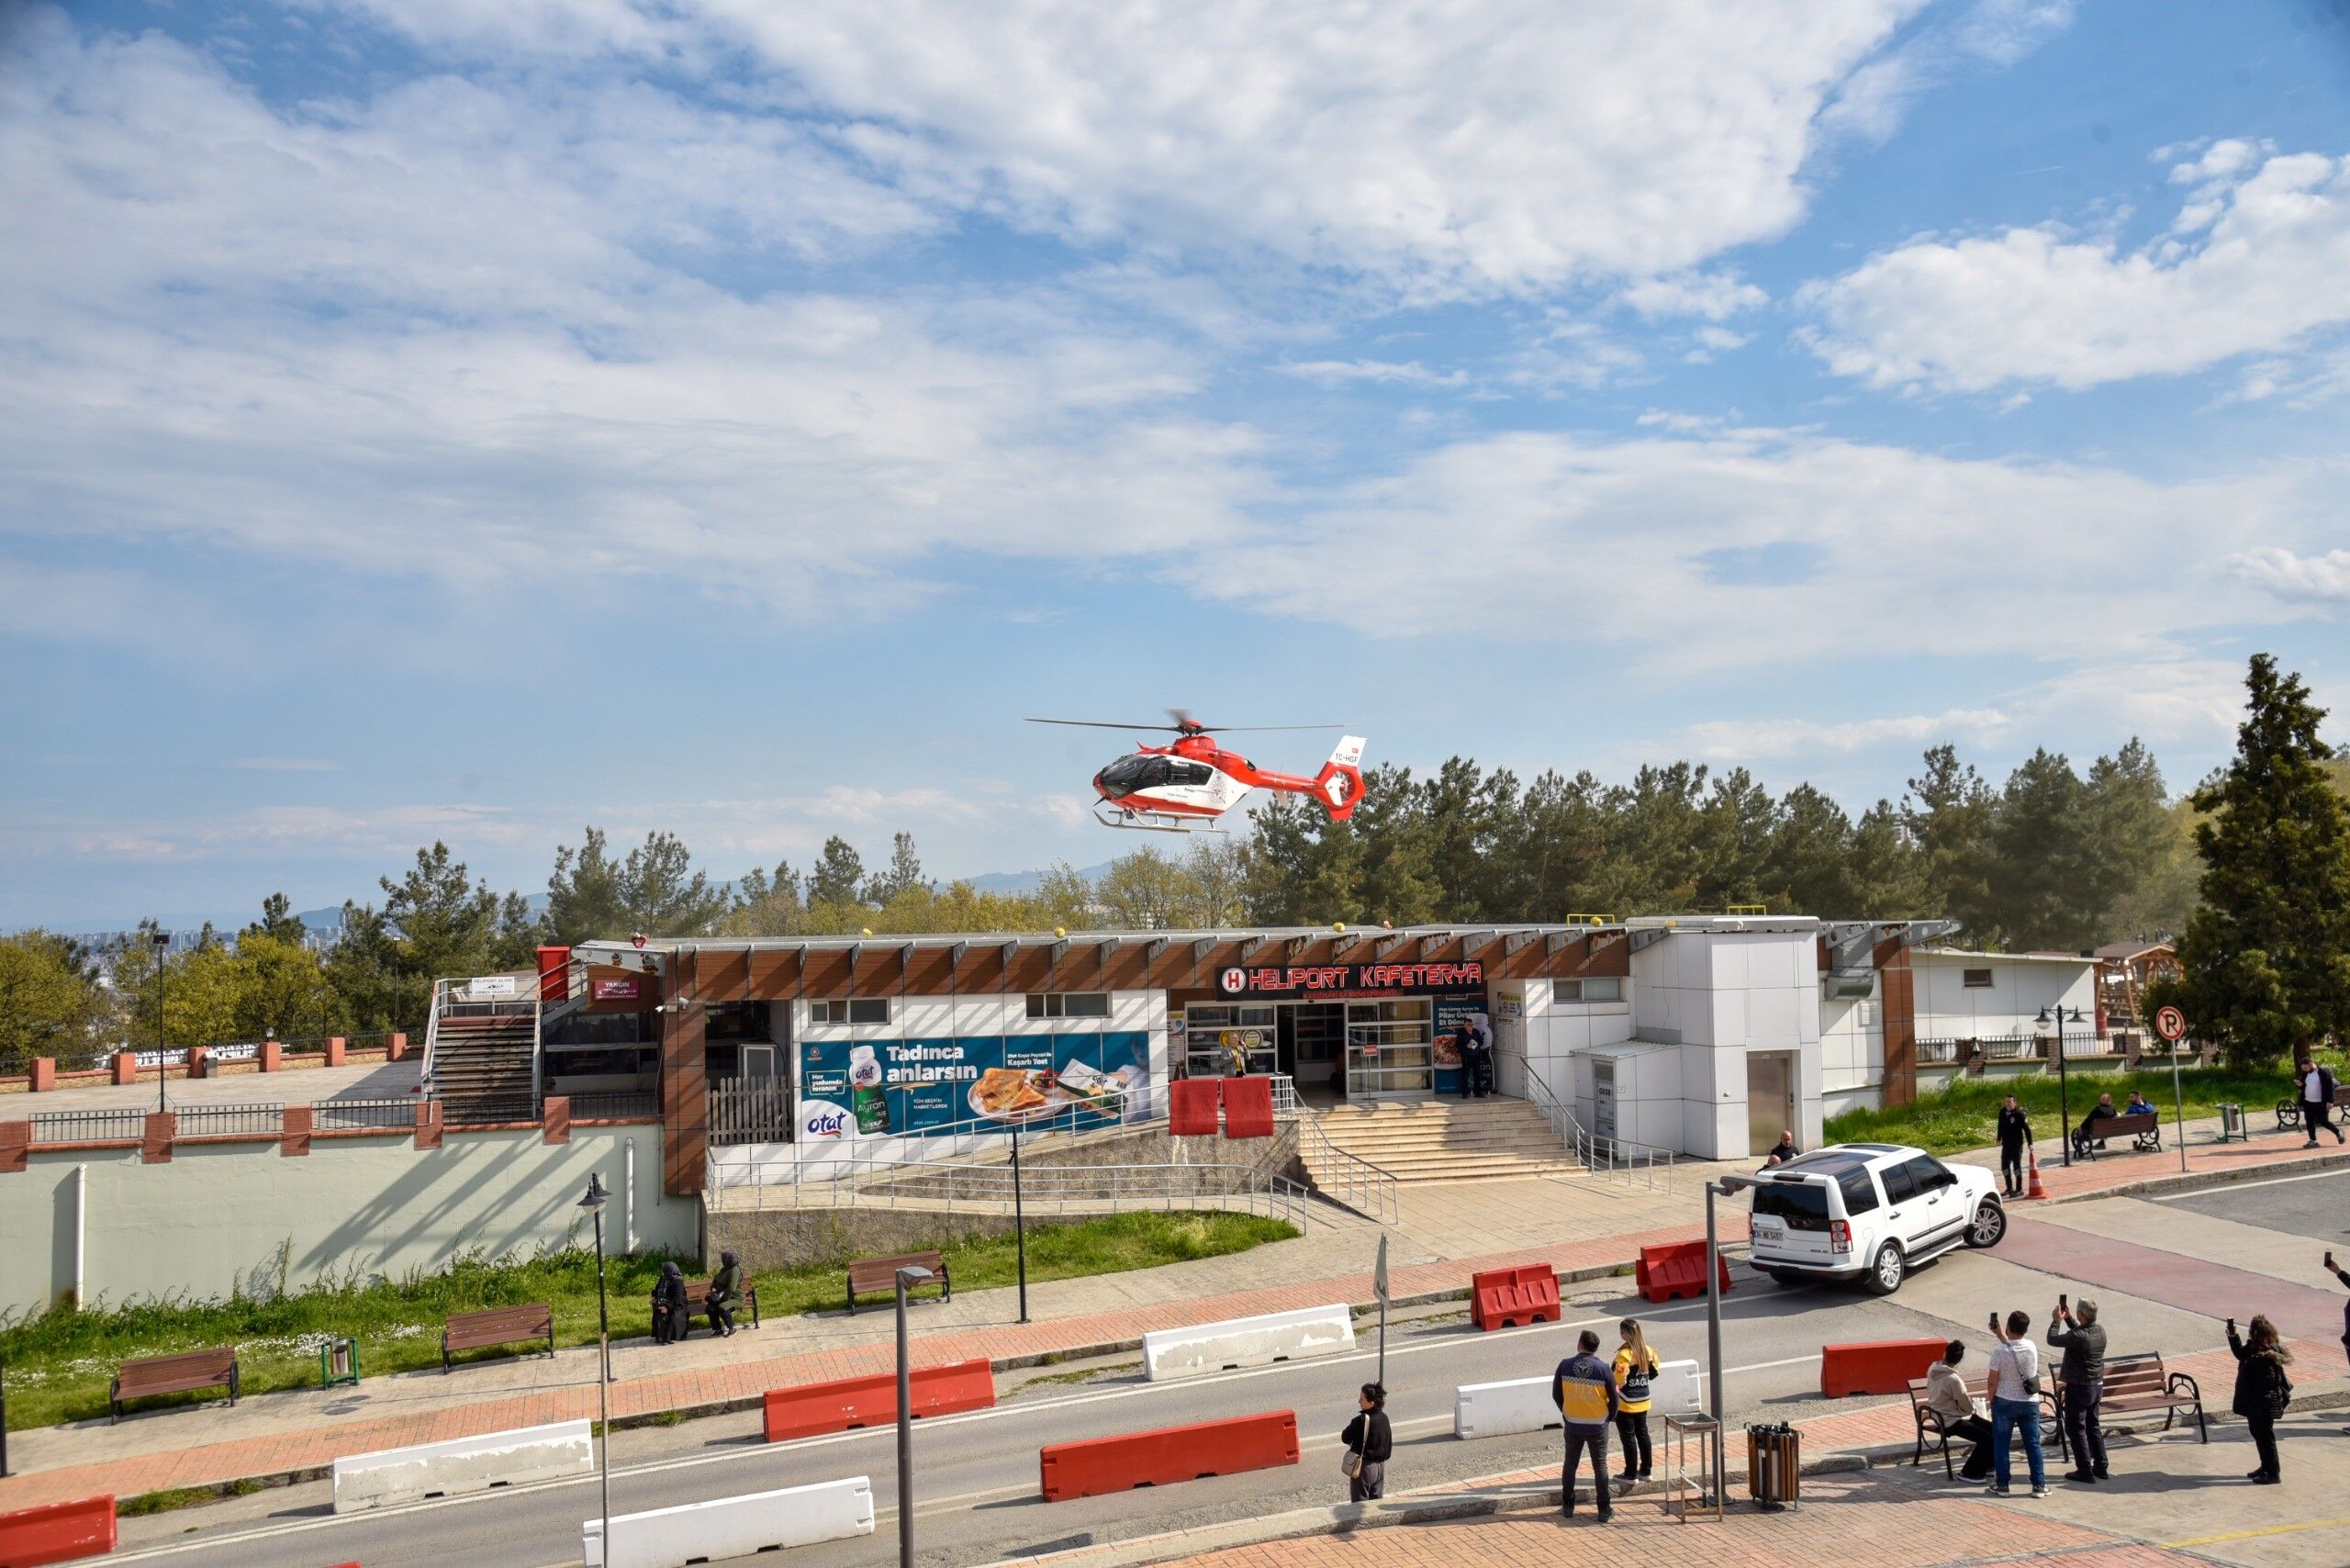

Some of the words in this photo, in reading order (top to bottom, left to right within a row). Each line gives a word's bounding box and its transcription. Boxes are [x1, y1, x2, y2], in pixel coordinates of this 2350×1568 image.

[1360, 963, 1482, 986] KAFETERYA
[887, 1045, 965, 1062] Tadınca
[1007, 1058, 1032, 1067] Kaşarlı
[856, 1066, 875, 1079] otat
[887, 1064, 978, 1082] anlarsın
[857, 1101, 886, 1113] Ayran
[808, 1111, 846, 1133] otat
[1628, 1378, 1649, 1388] SAĞL
